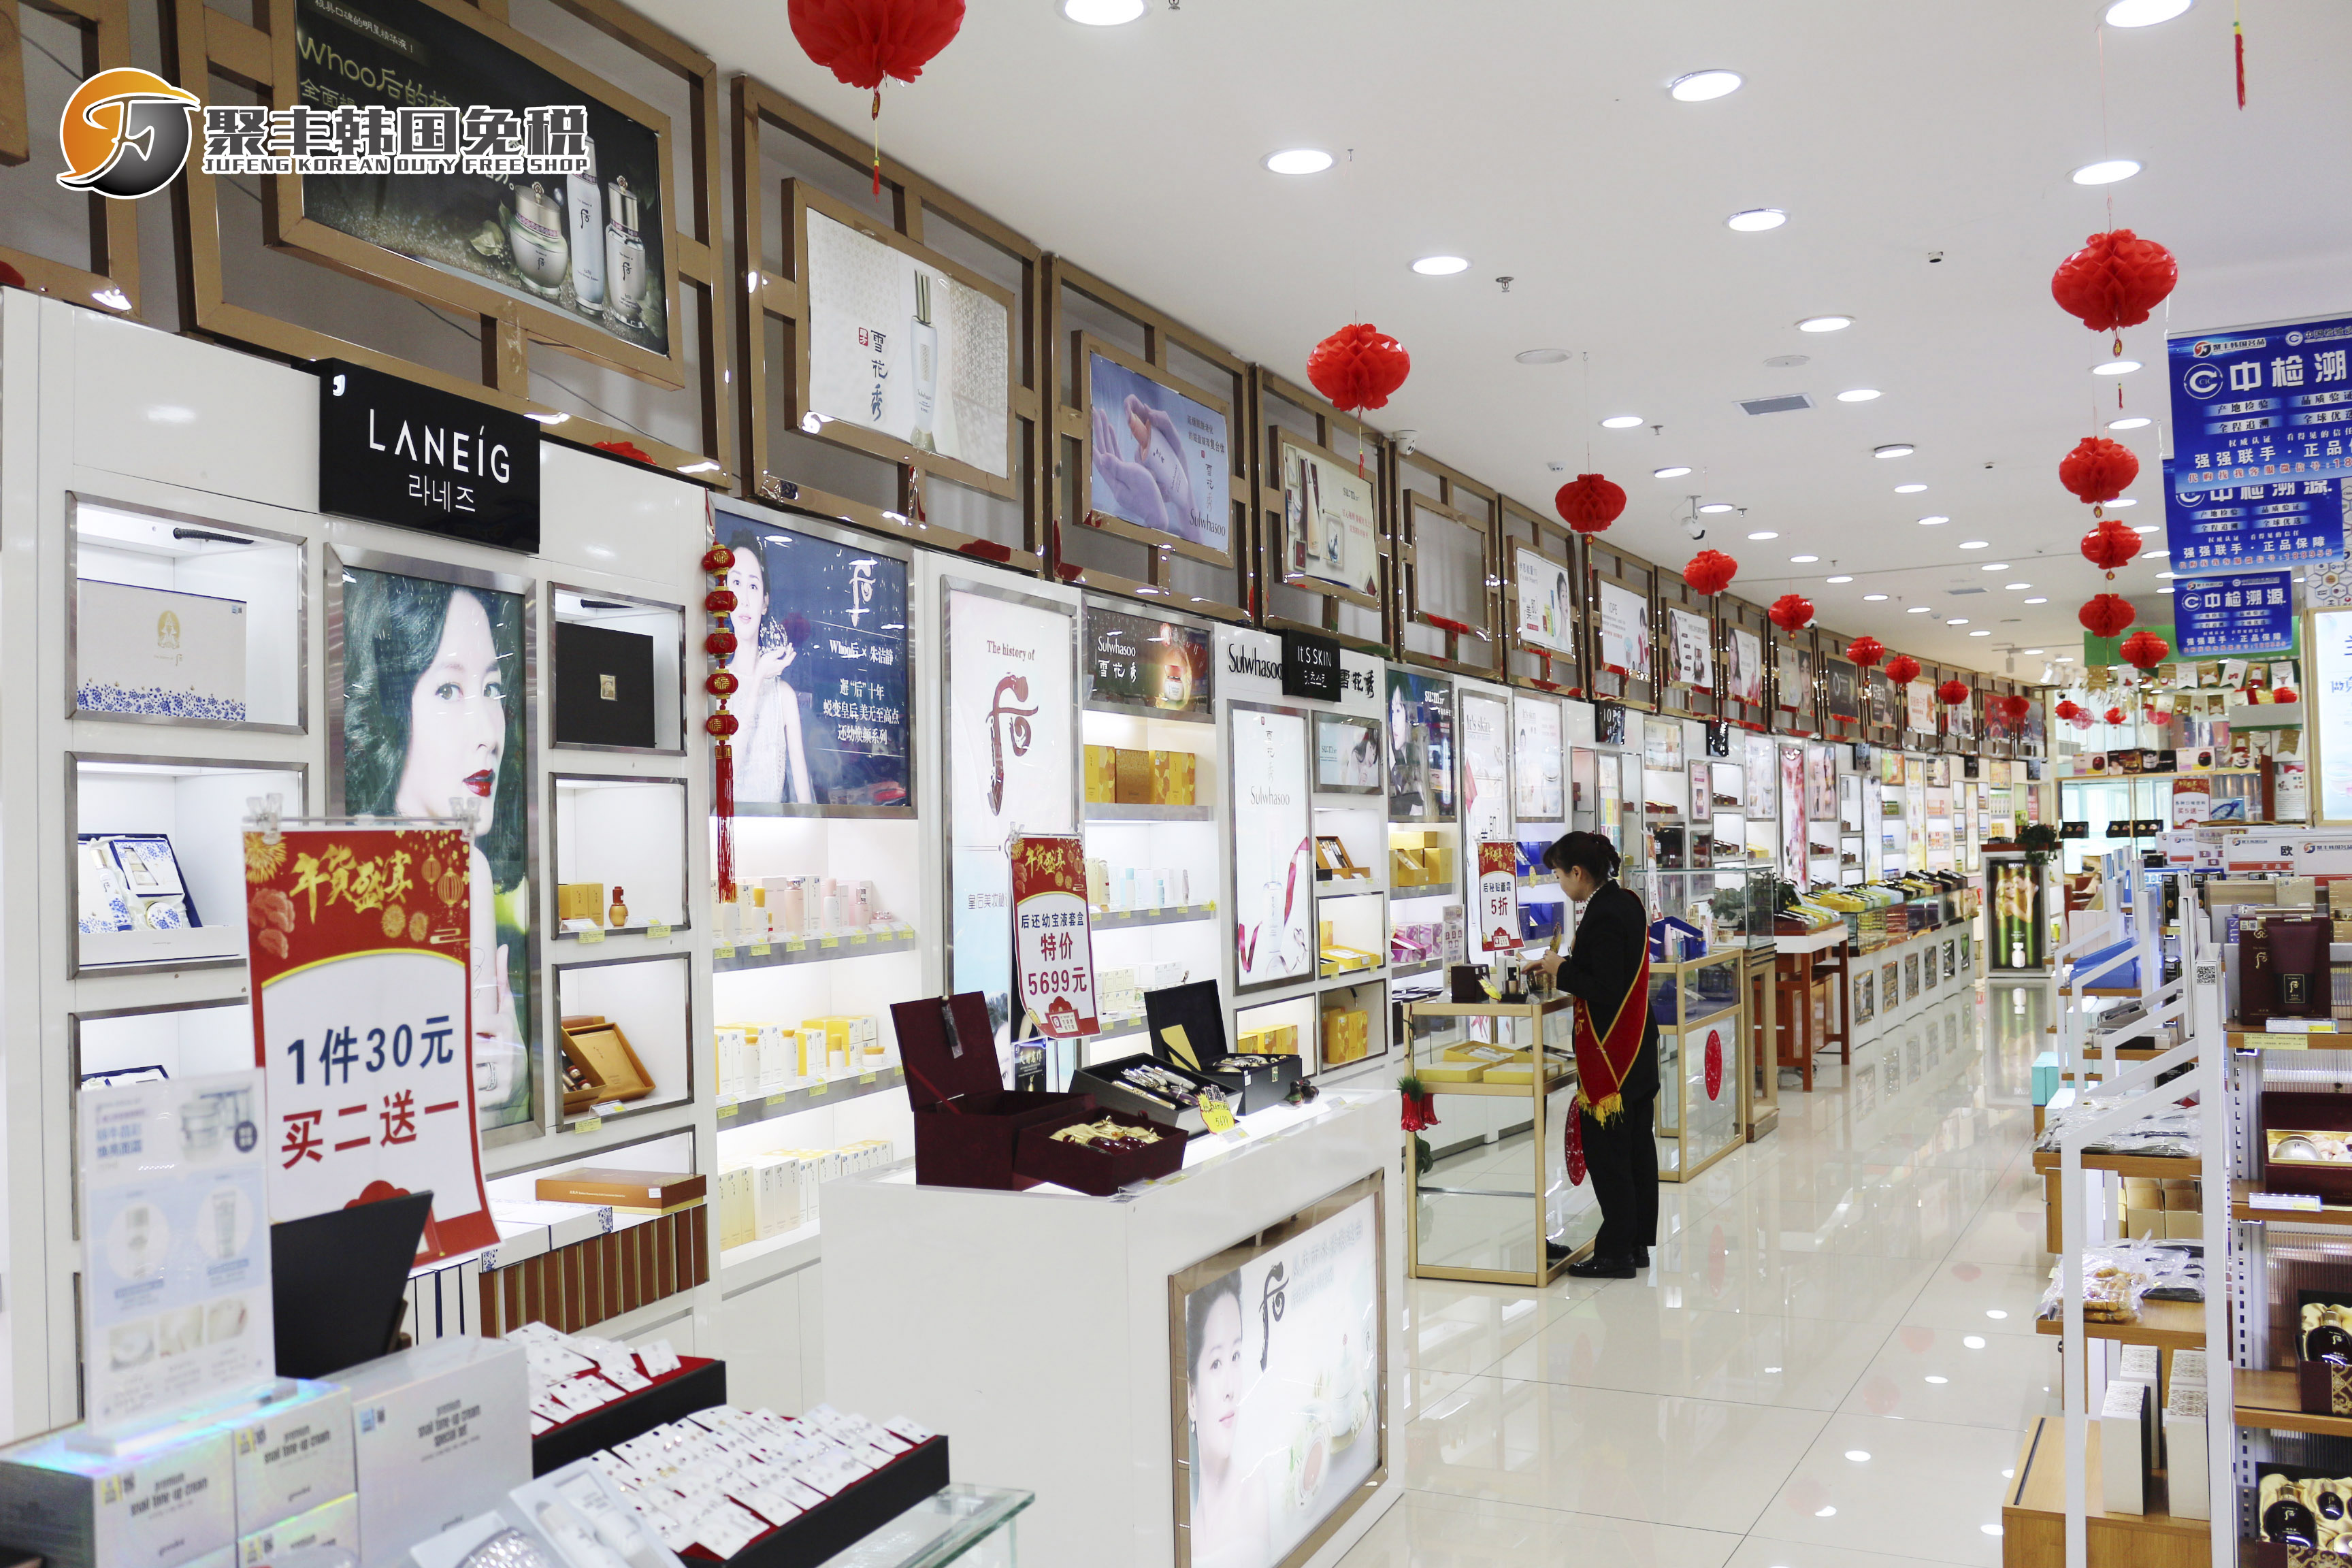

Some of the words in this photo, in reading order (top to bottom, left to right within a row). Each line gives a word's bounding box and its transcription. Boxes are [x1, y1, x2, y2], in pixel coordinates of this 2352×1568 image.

[870, 329, 888, 422] 雪花秀
[2230, 350, 2347, 391] 中检溯
[2217, 399, 2269, 415] 产地检验
[2219, 418, 2270, 434] 全程追溯
[408, 474, 476, 512] 라네즈
[1189, 508, 1226, 536] Sulwhasoo
[2204, 588, 2284, 608] 中检溯源
[986, 639, 1001, 655] The
[1002, 642, 1027, 663] history
[1028, 649, 1036, 662] of
[1097, 636, 1137, 657] Sulwhasoo
[1228, 642, 1283, 680] Sulwhasoo
[1313, 650, 1332, 668] SKIN
[1098, 659, 1137, 684] 雪花秀
[1340, 668, 1375, 699] 雪花秀
[1467, 713, 1476, 732] It's
[1477, 716, 1490, 734] skin
[1250, 785, 1291, 806] Sulwhasoo
[2280, 845, 2293, 857] 欧
[1490, 896, 1508, 916] 5折
[1021, 911, 1084, 929] 后还幼宝液套盒
[1040, 931, 1073, 962] 特价
[1028, 966, 1088, 996] 5699元
[287, 1015, 454, 1086] 1件30元
[281, 1089, 460, 1171] 买二送一
